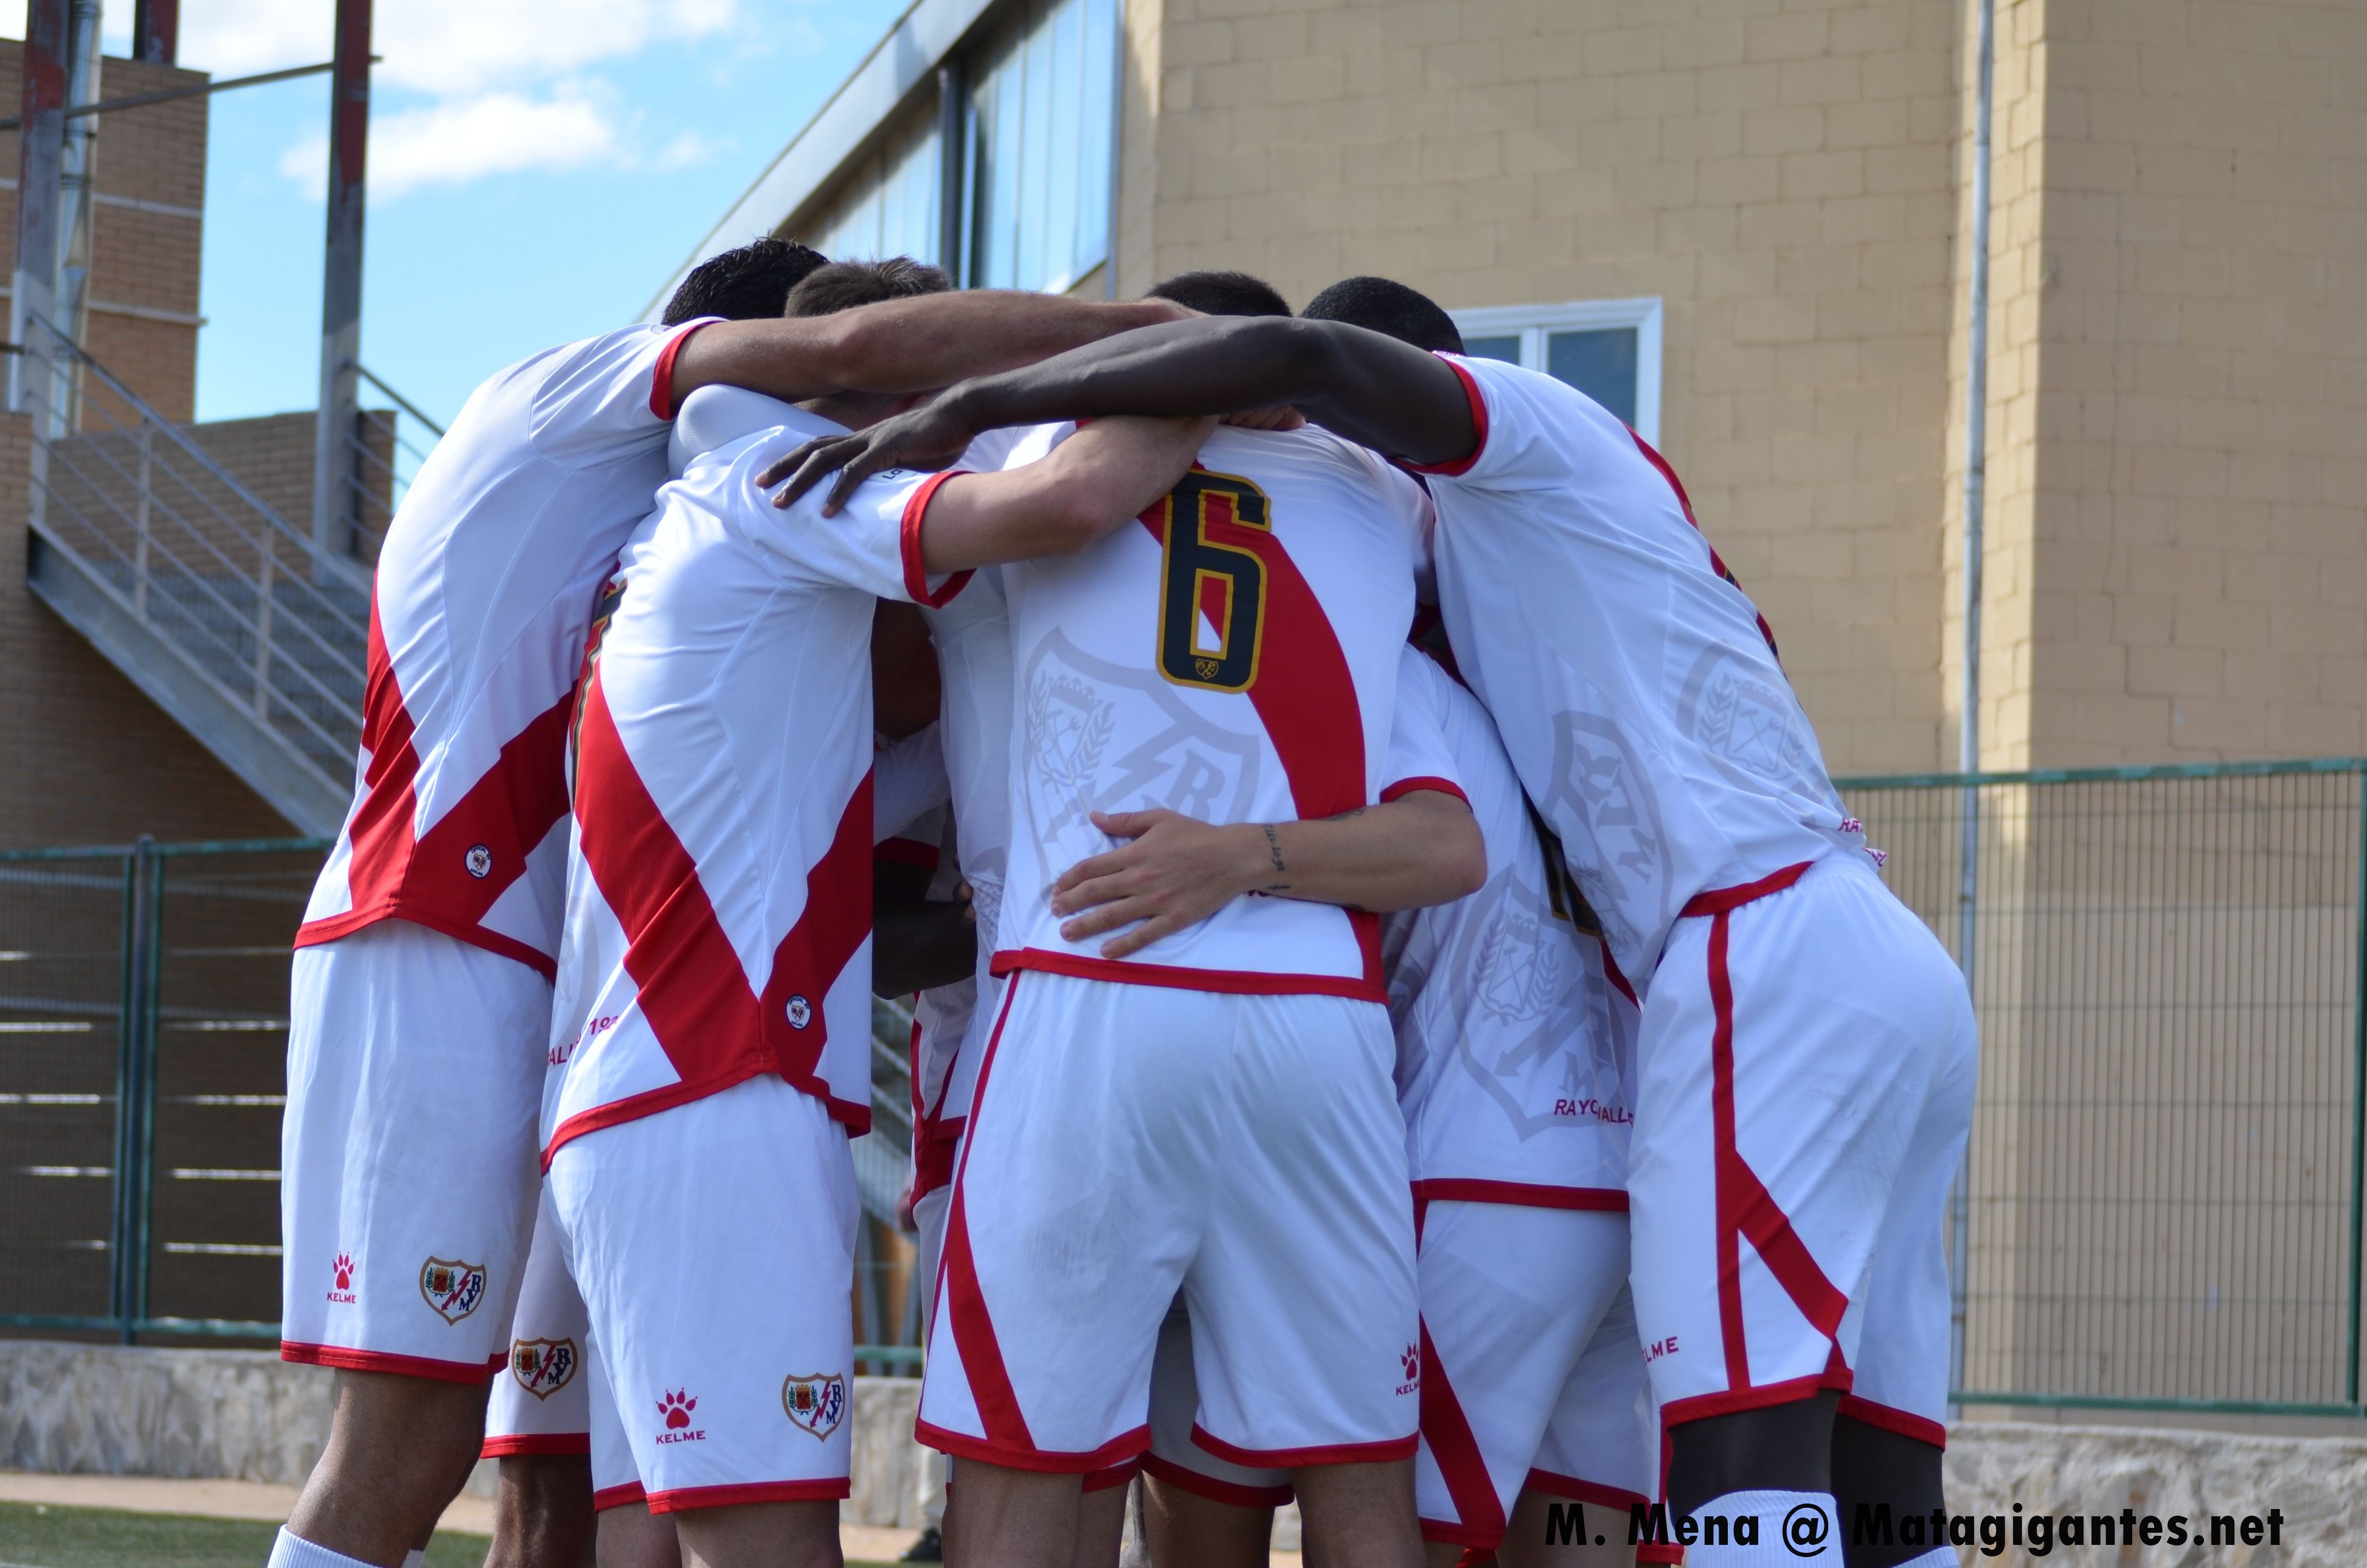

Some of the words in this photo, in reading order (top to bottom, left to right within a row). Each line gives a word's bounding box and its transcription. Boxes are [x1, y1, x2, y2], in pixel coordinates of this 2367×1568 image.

[1156, 468, 1272, 695] 6
[327, 1291, 356, 1303] KELME
[655, 1430, 706, 1445] KELME
